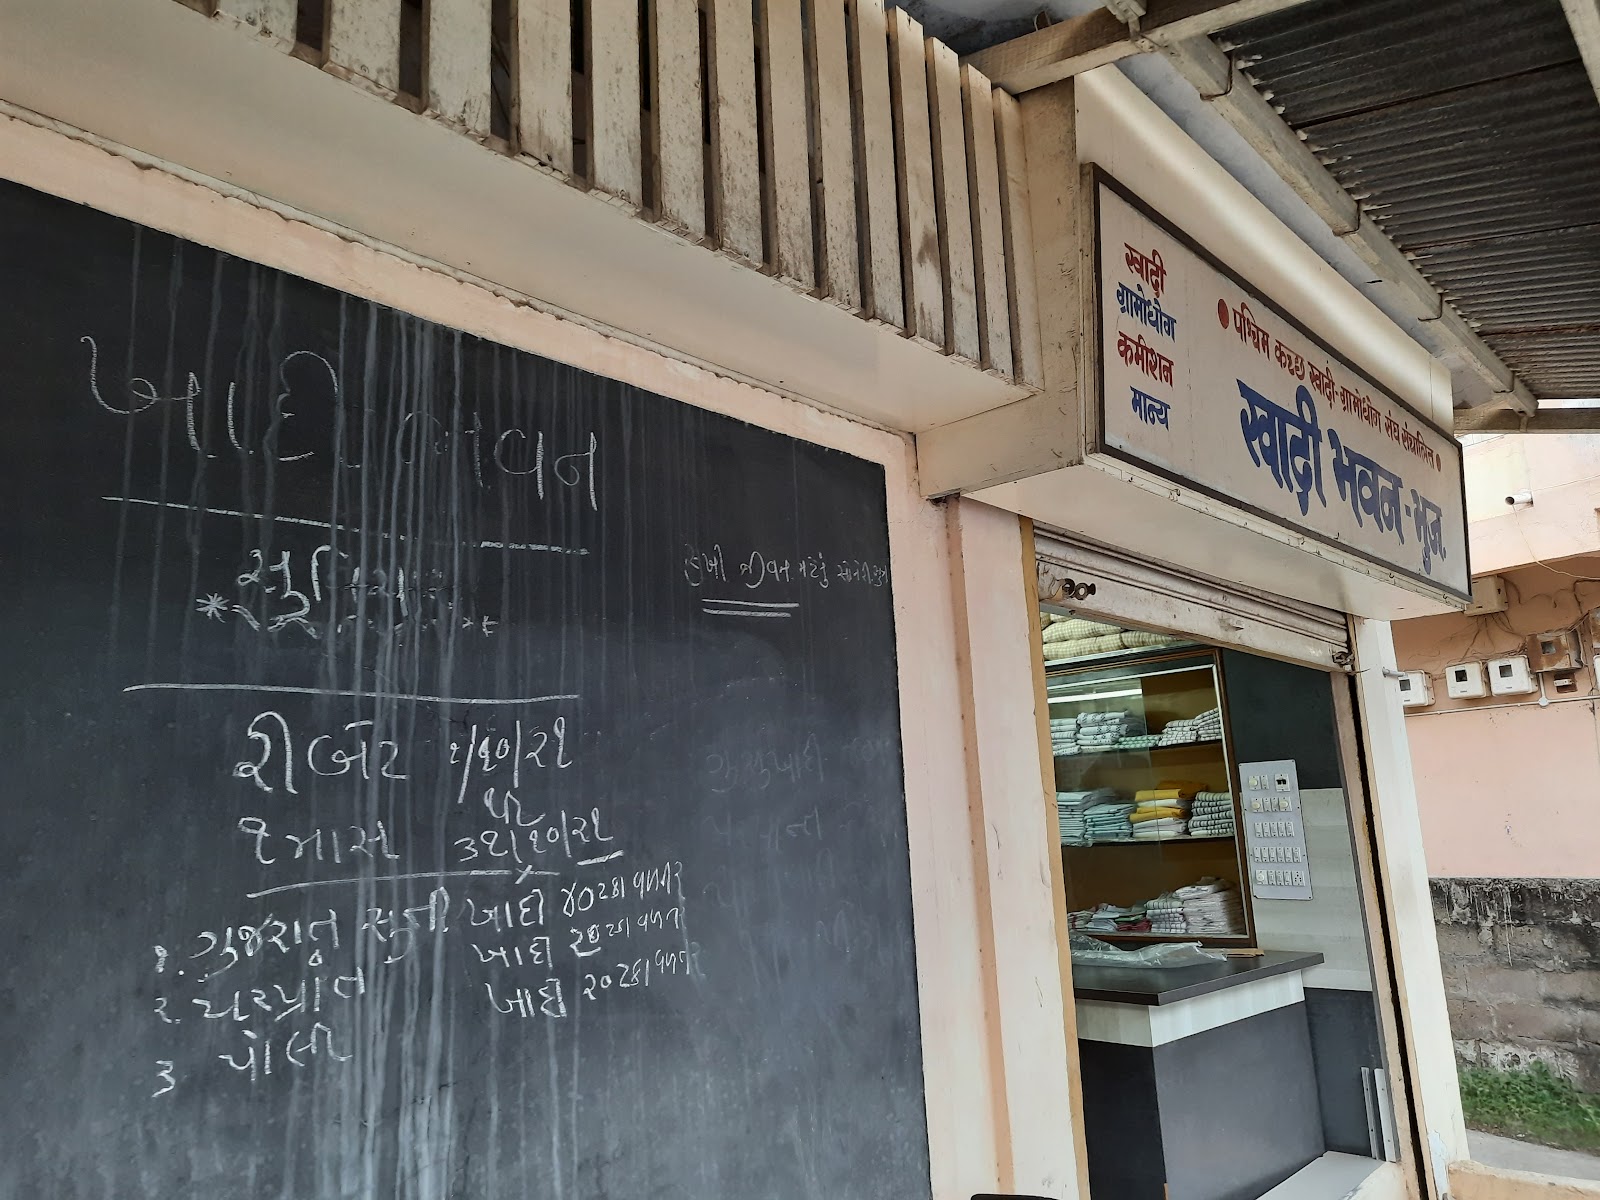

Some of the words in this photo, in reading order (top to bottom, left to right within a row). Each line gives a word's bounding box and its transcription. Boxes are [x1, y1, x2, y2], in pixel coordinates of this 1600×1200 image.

[1124, 242, 1167, 298] खादी
[1117, 330, 1175, 388] कमीशन
[1232, 302, 1270, 361] पश्चिम
[1130, 385, 1171, 431] मान्य
[1236, 378, 1327, 516] खादी
